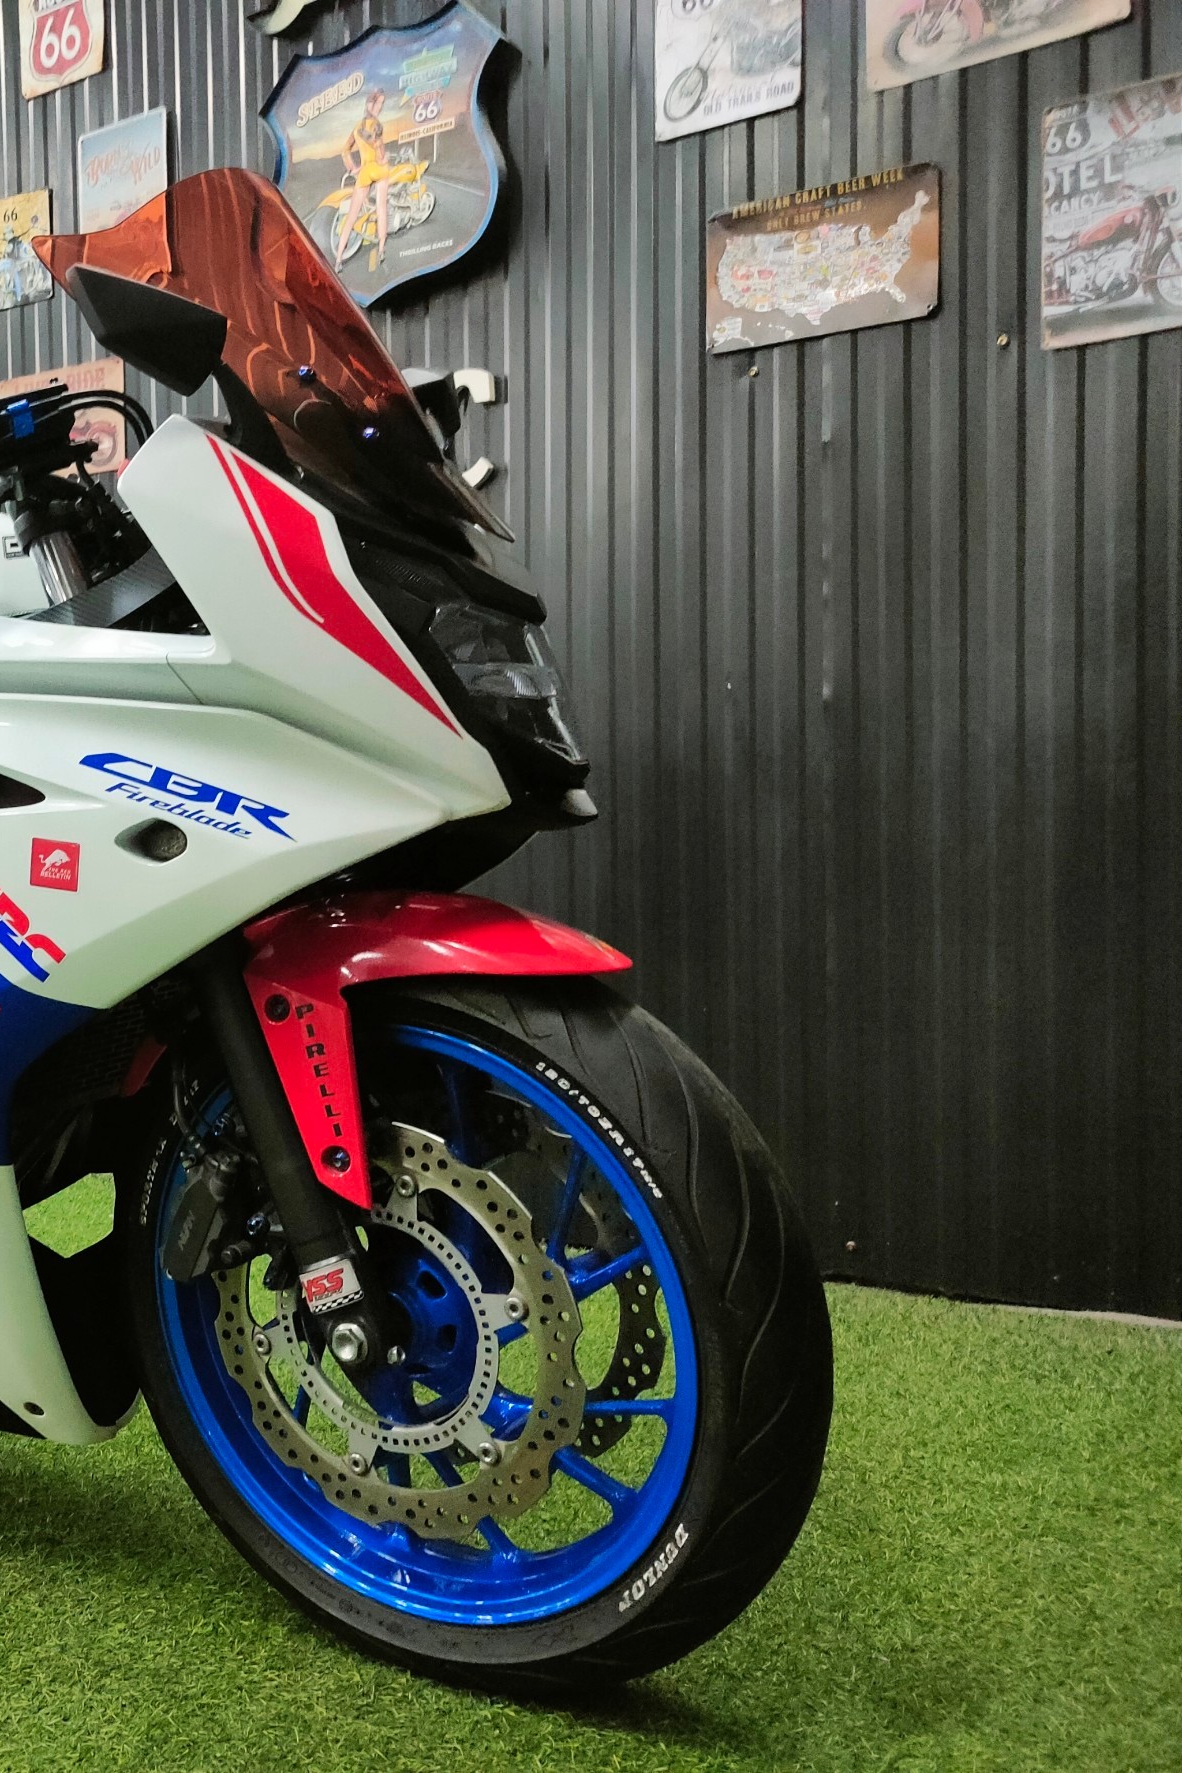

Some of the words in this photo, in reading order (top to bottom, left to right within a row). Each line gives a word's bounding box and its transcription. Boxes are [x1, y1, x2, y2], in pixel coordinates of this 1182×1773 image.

[40, 7, 81, 69] 66
[765, 81, 795, 97] ROAD
[415, 100, 438, 122] 66
[1046, 121, 1082, 154] 66
[732, 195, 791, 220] AMERICAN
[795, 186, 831, 204] CRAFT
[837, 176, 866, 195] BEER
[871, 168, 905, 187] WEEK
[3, 207, 18, 223] 66
[794, 210, 820, 225] BREW
[79, 752, 297, 843] CBR
[104, 782, 253, 840] Fireblade
[295, 1003, 343, 1137] PIRELLI
[302, 1267, 344, 1303] YSS
